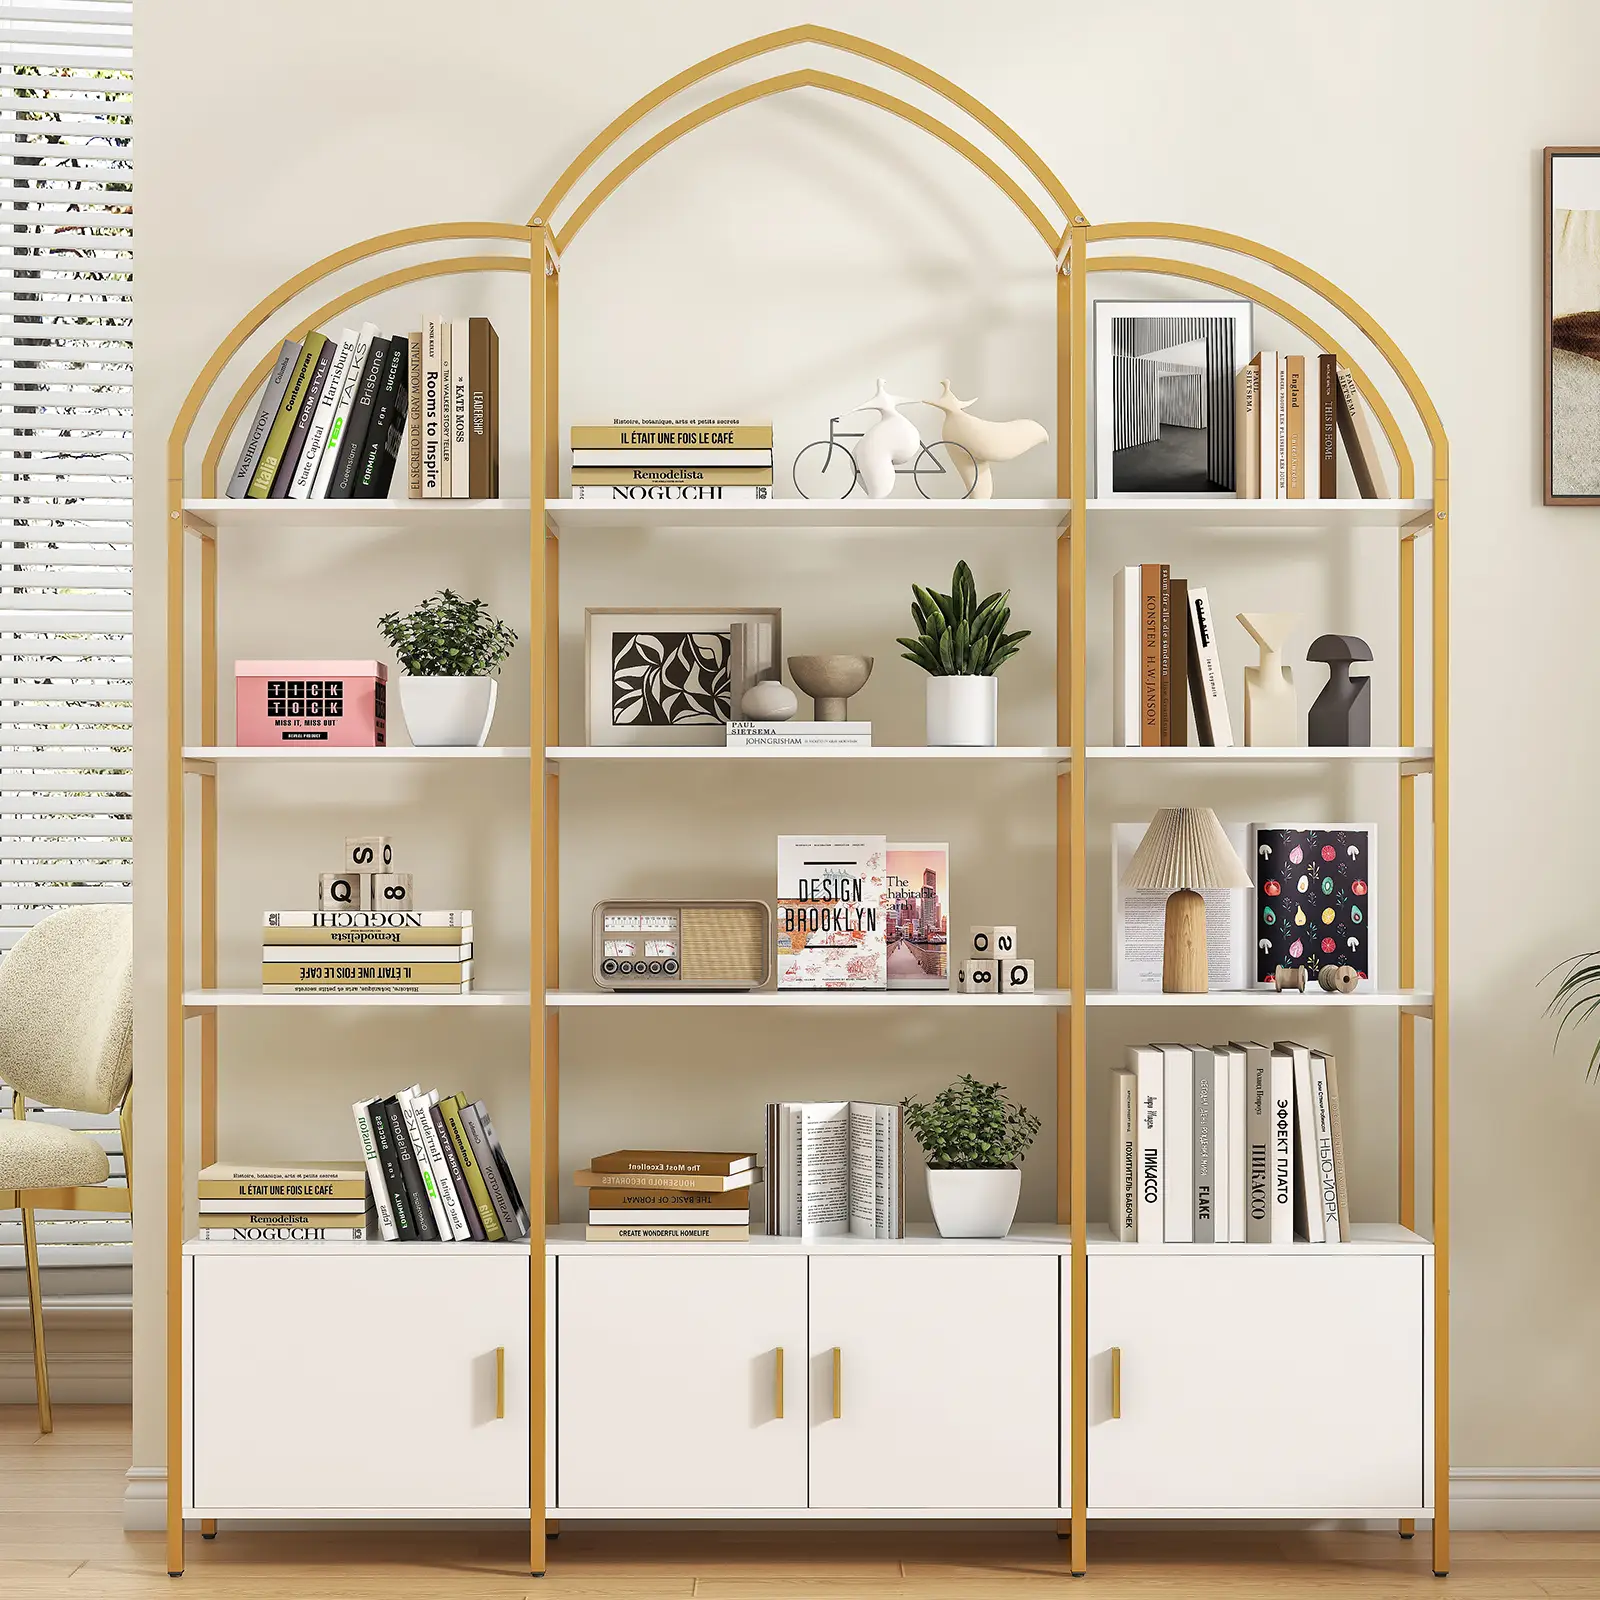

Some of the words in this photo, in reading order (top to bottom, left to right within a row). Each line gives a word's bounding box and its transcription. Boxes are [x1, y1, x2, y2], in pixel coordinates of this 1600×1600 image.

[275, 356, 290, 385] Columbia
[322, 341, 354, 408] Harrisburg
[360, 350, 384, 407] Brisbane
[410, 342, 420, 394] MOUNTAIN
[286, 352, 312, 412] Contemporan
[299, 396, 315, 429] FORM
[310, 357, 328, 394] STYLE
[1289, 373, 1299, 408] England
[1345, 373, 1357, 396] PAUL
[328, 416, 344, 450] TED
[339, 342, 368, 409] TALKS
[427, 371, 438, 418] Rooms
[456, 385, 464, 412] KATE
[1338, 375, 1357, 417] SIETSEMA
[362, 442, 379, 486] FORMULA
[377, 406, 387, 426] FOR
[386, 350, 401, 392] SUCCESS
[410, 397, 420, 420] GRAY
[473, 391, 483, 435] LEADERSHIP
[1325, 401, 1333, 422] THIS
[411, 424, 420, 436] DE
[427, 422, 438, 437] to
[456, 414, 464, 443] MOSS
[697, 418, 715, 426] petits
[1325, 424, 1333, 432] IS
[237, 410, 269, 480] WASHINGTON
[621, 432, 629, 444] IL
[631, 431, 656, 444] ÉTAIT
[657, 432, 675, 444] UNE
[677, 432, 698, 444] FOIS
[699, 432, 710, 444] LE
[712, 431, 734, 444] CAFÉ
[1325, 434, 1333, 460] HOME
[297, 462, 312, 486] State
[306, 425, 324, 460] Capital
[340, 443, 357, 490] Queensland
[410, 439, 420, 480] SECRETO
[424, 441, 439, 488] Inspire
[254, 456, 277, 491] Italia
[633, 469, 704, 480] Remodelista
[411, 481, 419, 490] EL
[612, 486, 723, 499] NOGUCHI
[1147, 596, 1156, 648] KONSTEN
[1162, 625, 1170, 637] die
[272, 683, 339, 696] TICK
[1146, 656, 1156, 726] H.W.JANSON
[272, 701, 339, 714] TOCK
[293, 719, 302, 727] IT,
[330, 880, 352, 903] Q
[384, 885, 406, 900] 8
[799, 878, 862, 903] DESIGN
[886, 876, 909, 887] The
[886, 888, 936, 899] habitable
[312, 913, 422, 927] NOGUCHI
[785, 908, 876, 932] BROOKLYN
[331, 933, 401, 943] Remodelista
[300, 967, 322, 981] CAFÉ
[324, 967, 334, 979] LE
[336, 967, 355, 979] FOIS
[358, 967, 376, 979] UNE
[377, 967, 401, 981] ÉTAIT
[403, 967, 412, 979] IL
[973, 970, 991, 983] 8
[1277, 1099, 1288, 1154] ЭФФЕКТ
[1125, 1141, 1133, 1192] ПОХИТИТЕЛЬ
[1144, 1148, 1157, 1204] ПИКАССО
[239, 1186, 246, 1195] IL
[247, 1184, 268, 1195] ÉTAIT
[270, 1186, 285, 1195] UNE
[286, 1186, 303, 1195] FOIS
[304, 1186, 313, 1195] LE
[314, 1184, 333, 1195] CAFÉ
[1251, 1143, 1266, 1220] ПИКАССО
[1277, 1158, 1288, 1204] ПЛАТО
[1319, 1137, 1338, 1223] НЬЮ-ЙОРК
[622, 1196, 656, 1204] FORMAT
[658, 1196, 669, 1204] OF
[671, 1196, 694, 1204] BASIC
[1125, 1193, 1133, 1229] БАБОЧЕК
[1198, 1186, 1210, 1220] FLAKE
[250, 1215, 309, 1223] Remodelista
[233, 1228, 325, 1240] NOGUCHI
